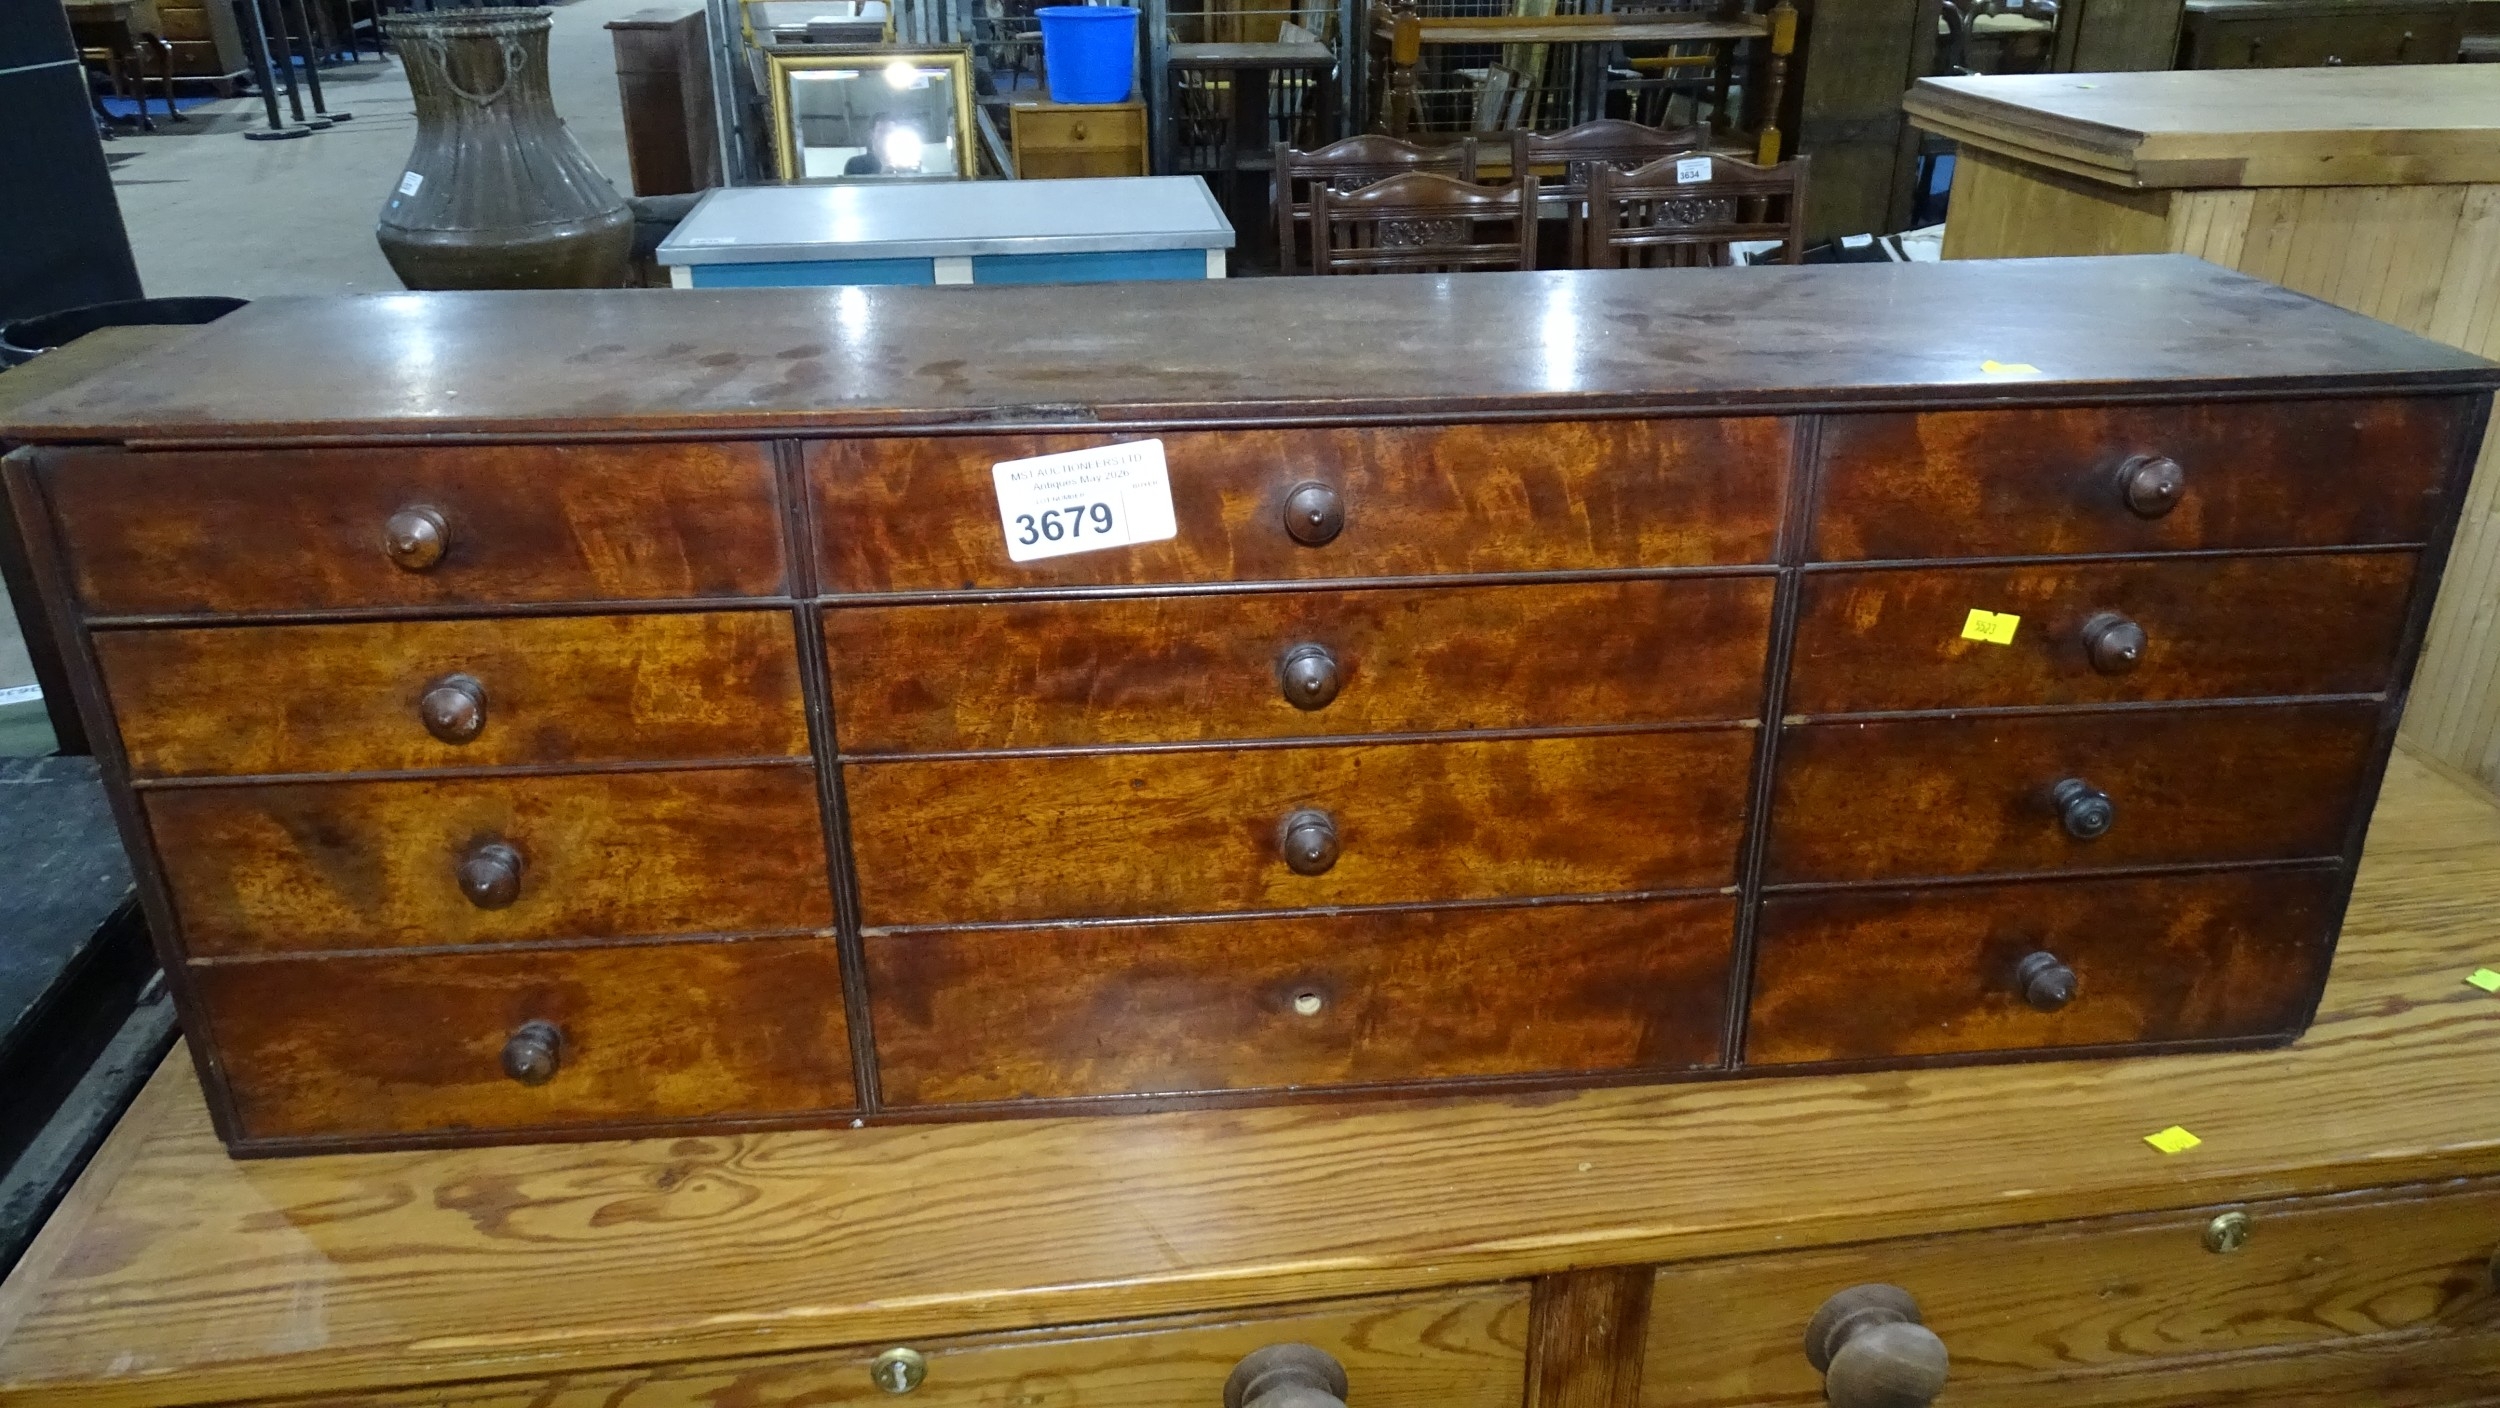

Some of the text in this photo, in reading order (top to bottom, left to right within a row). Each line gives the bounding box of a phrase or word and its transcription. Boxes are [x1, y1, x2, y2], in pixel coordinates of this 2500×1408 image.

[1680, 170, 1699, 180] 3634
[1037, 456, 1119, 477] AUCTIONEERS
[1034, 470, 1130, 491] Antiques May 2026
[1015, 502, 1113, 545] 3679
